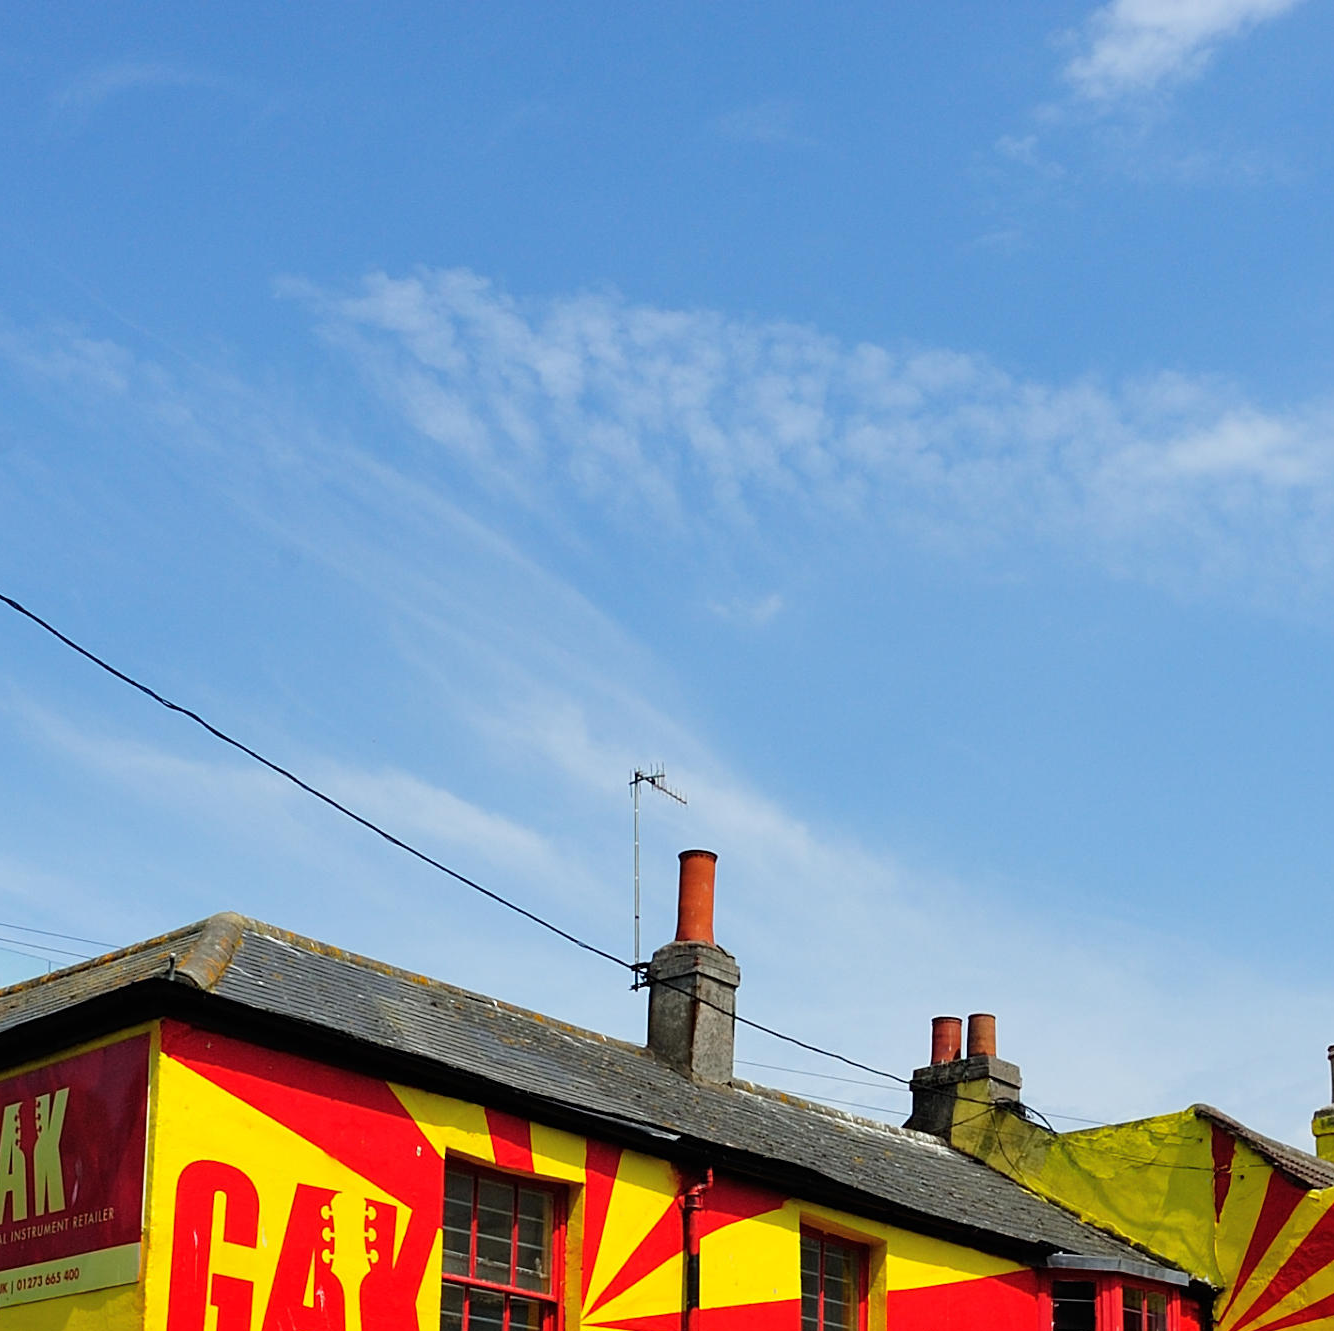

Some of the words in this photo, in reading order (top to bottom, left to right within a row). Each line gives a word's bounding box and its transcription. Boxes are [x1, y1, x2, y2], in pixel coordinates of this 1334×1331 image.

[10, 1219, 69, 1242] INSTRUMENT
[72, 1207, 115, 1230] RETAILER
[17, 1274, 43, 1291] 01273
[45, 1270, 62, 1287] 665
